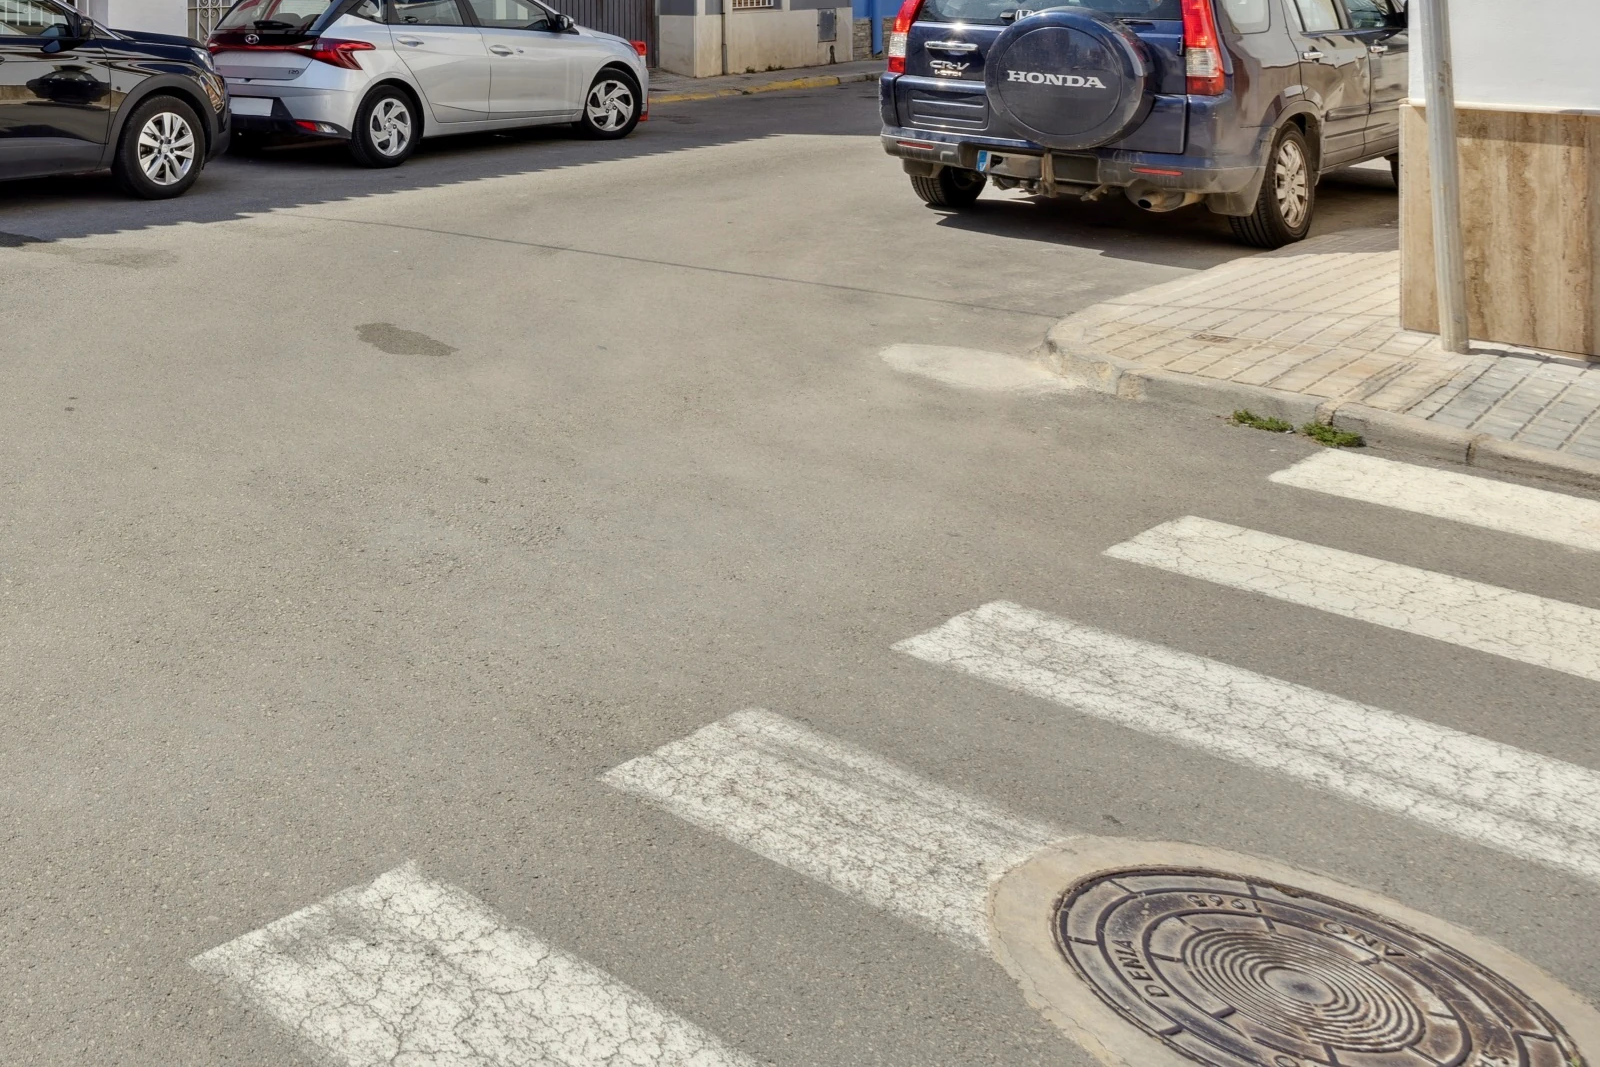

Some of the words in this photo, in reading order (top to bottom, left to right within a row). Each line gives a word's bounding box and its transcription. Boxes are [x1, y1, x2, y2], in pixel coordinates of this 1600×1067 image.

[929, 59, 970, 71] CR-V
[1007, 69, 1107, 89] HONDA
[1111, 939, 1171, 998] DENIA
